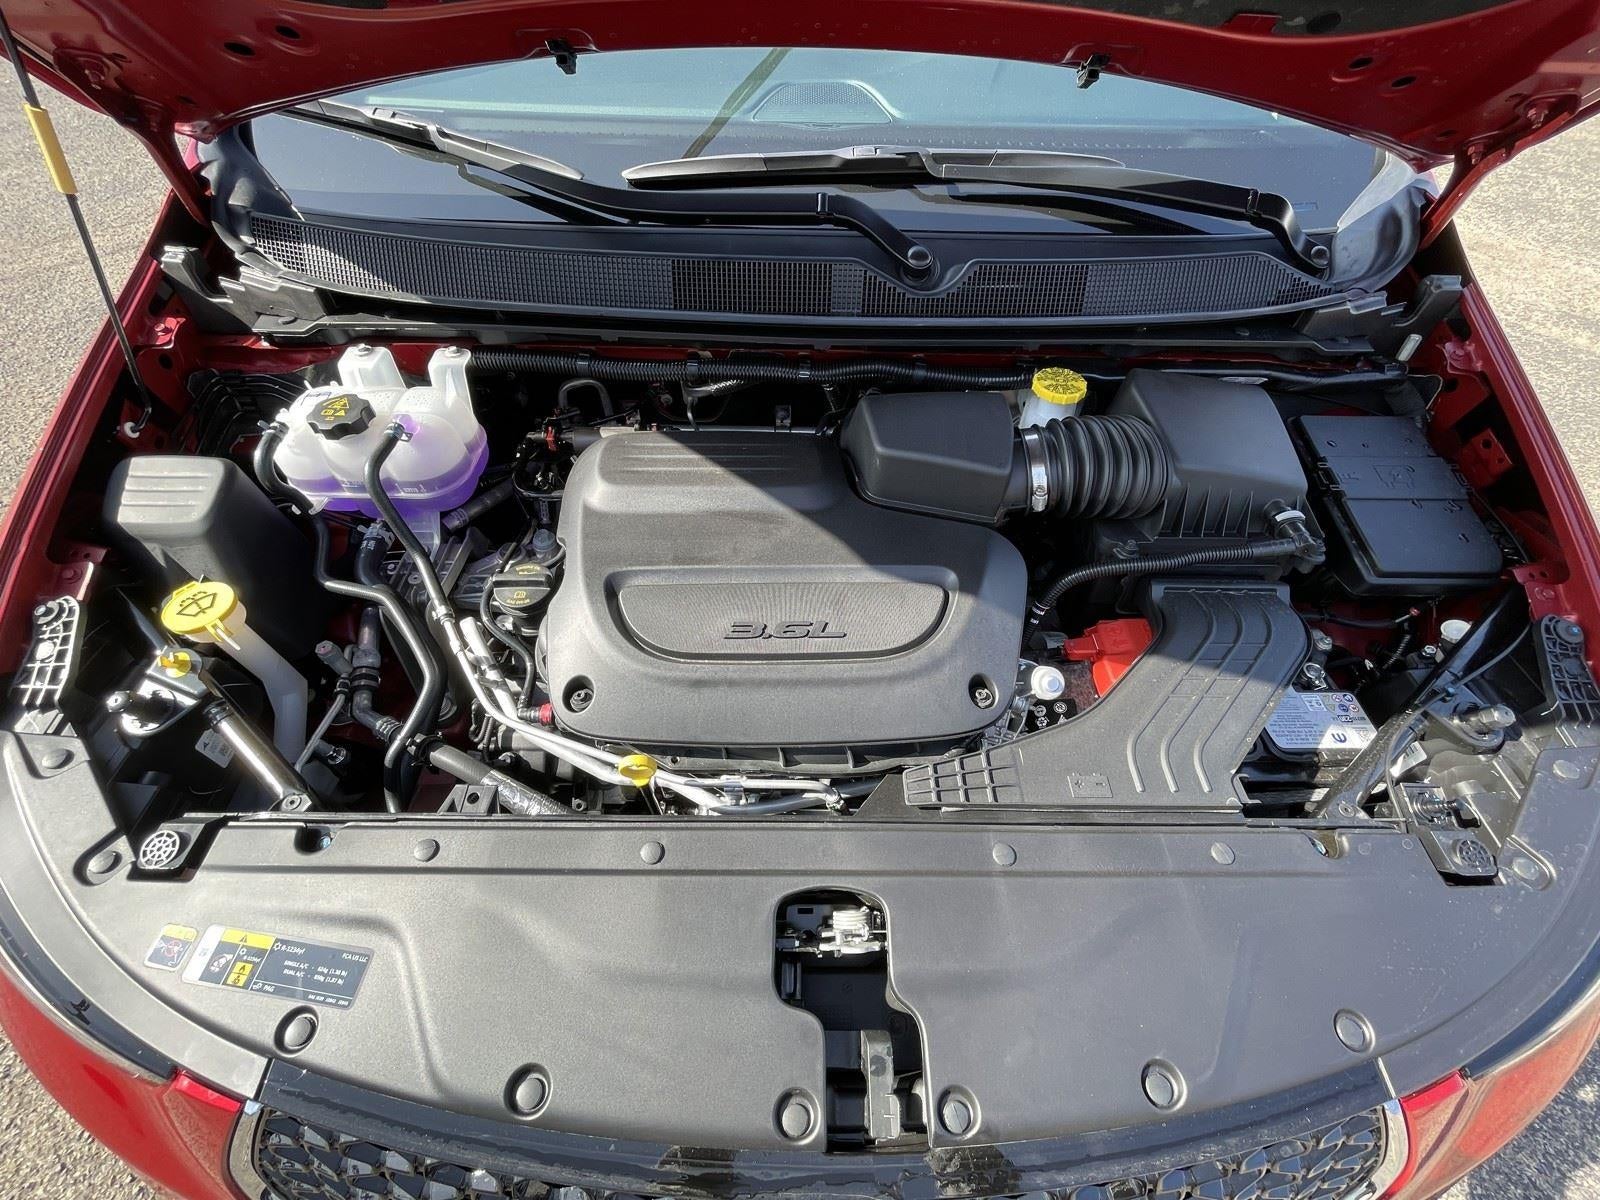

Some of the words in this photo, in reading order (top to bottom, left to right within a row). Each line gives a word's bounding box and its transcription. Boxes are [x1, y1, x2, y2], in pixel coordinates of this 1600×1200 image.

[723, 621, 848, 639] 3.6L
[342, 952, 352, 960] FCA
[359, 955, 368, 963] LLC
[263, 984, 275, 993] PAG
